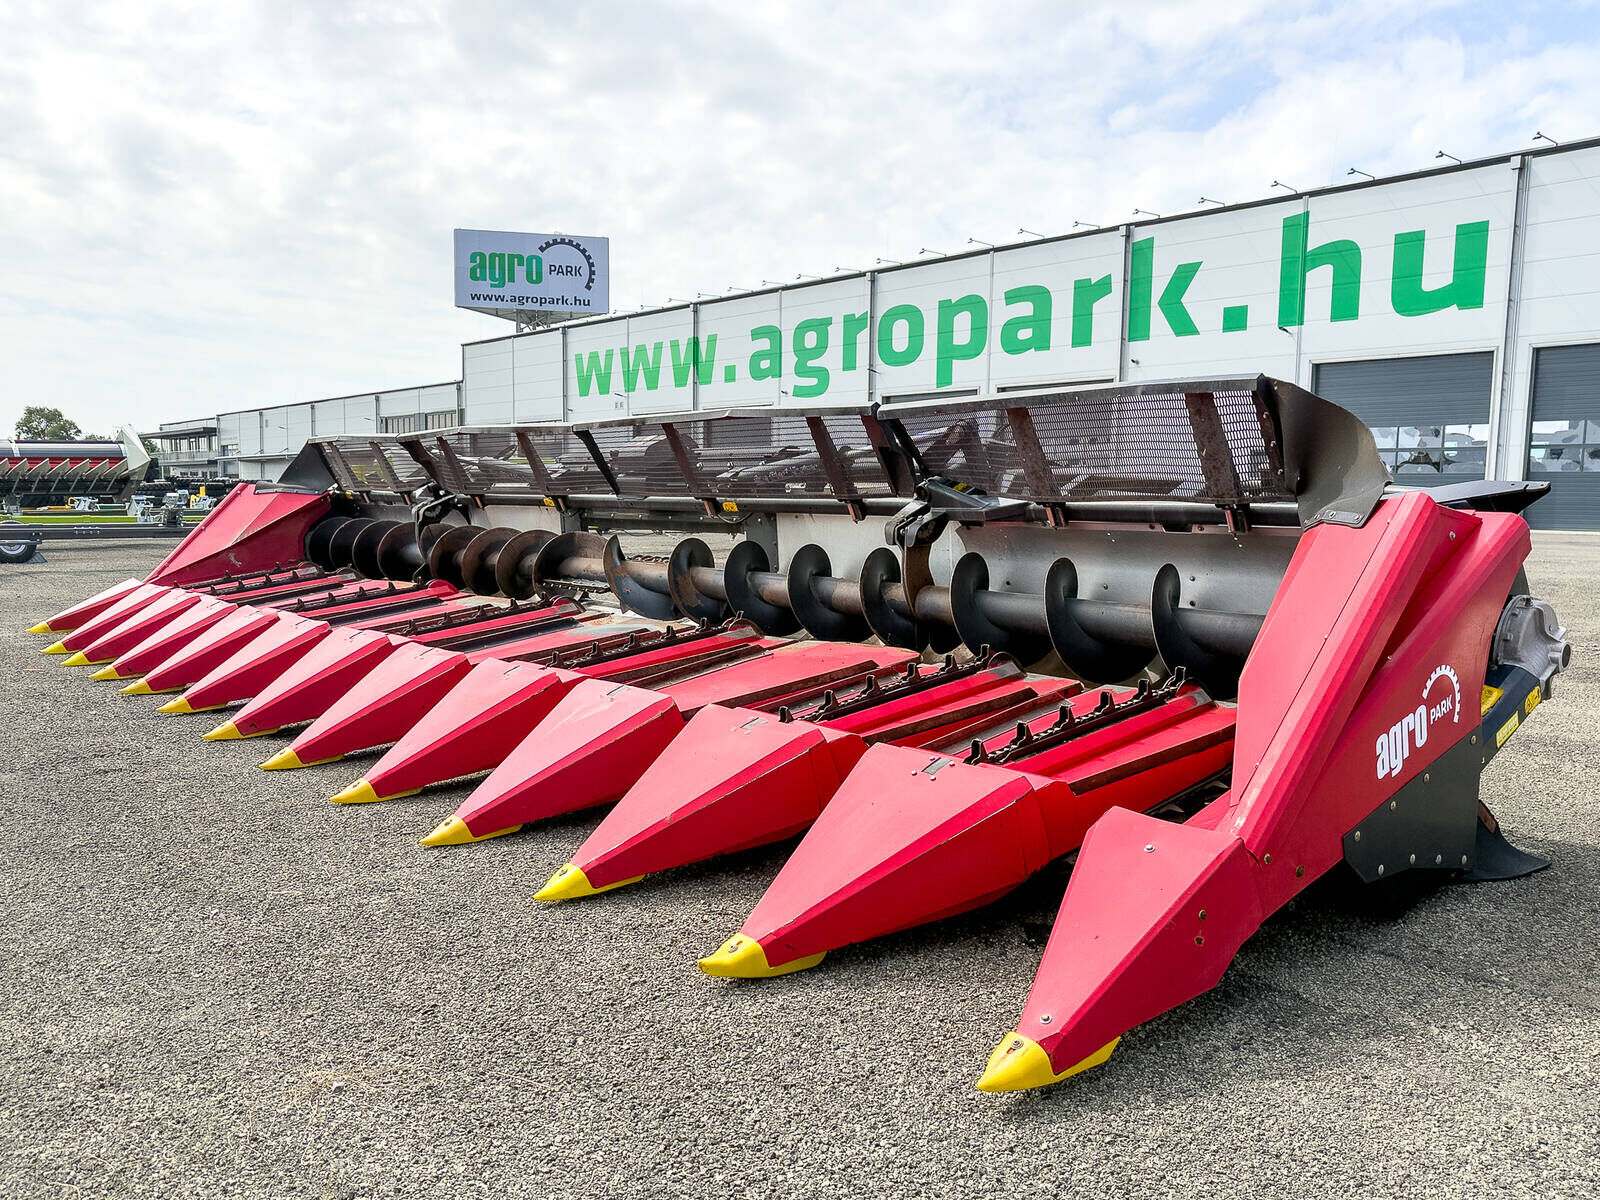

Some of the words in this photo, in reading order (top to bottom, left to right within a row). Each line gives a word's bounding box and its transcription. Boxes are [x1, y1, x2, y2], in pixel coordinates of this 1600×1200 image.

[470, 251, 543, 288] agro
[549, 264, 583, 277] PARK
[470, 293, 591, 307] www.agropark.hu
[575, 211, 1489, 398] www.agropark.hu
[1376, 704, 1428, 780] agro
[1430, 694, 1453, 725] PARK
